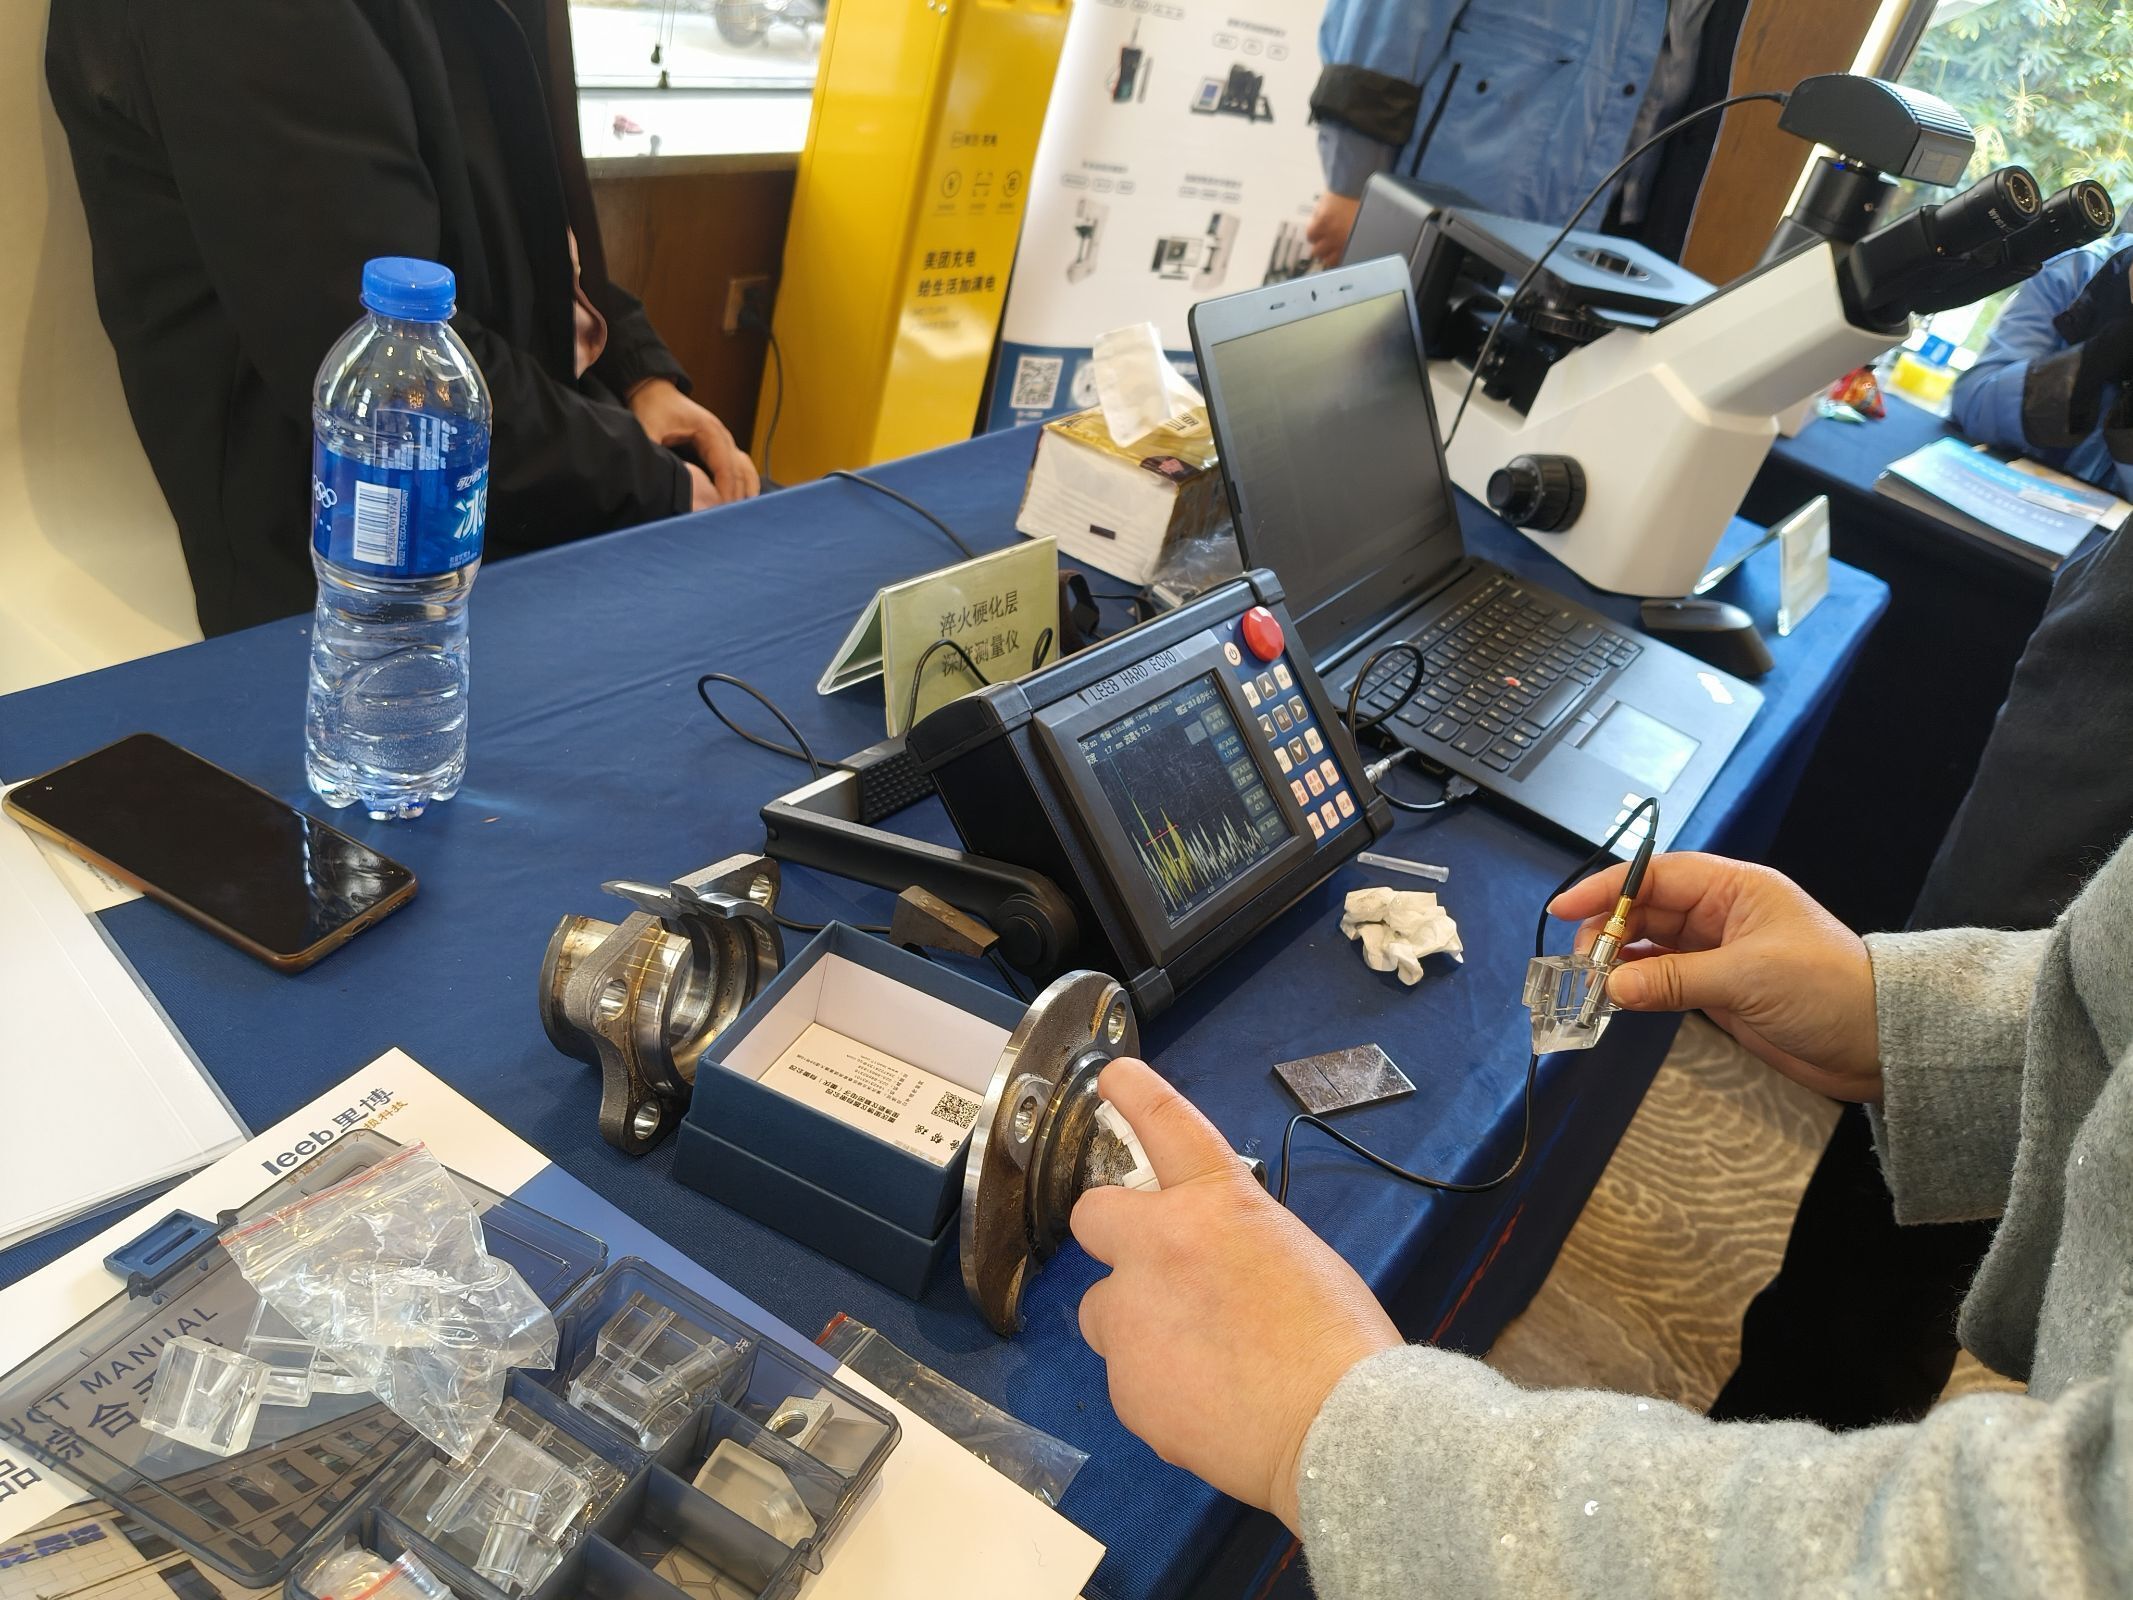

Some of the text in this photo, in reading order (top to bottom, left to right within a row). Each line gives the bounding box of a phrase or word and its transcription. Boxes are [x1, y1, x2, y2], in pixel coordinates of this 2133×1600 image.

[923, 250, 977, 271] 美团充电
[917, 275, 997, 298] 给生活加满电
[453, 490, 487, 540] 冰
[940, 590, 1019, 637] 淬火硬化层
[1088, 650, 1177, 701] LEEB HARD ECHO
[261, 1128, 335, 1176] leeb
[332, 1087, 394, 1134] 里博
[79, 1307, 219, 1395] MANUAL
